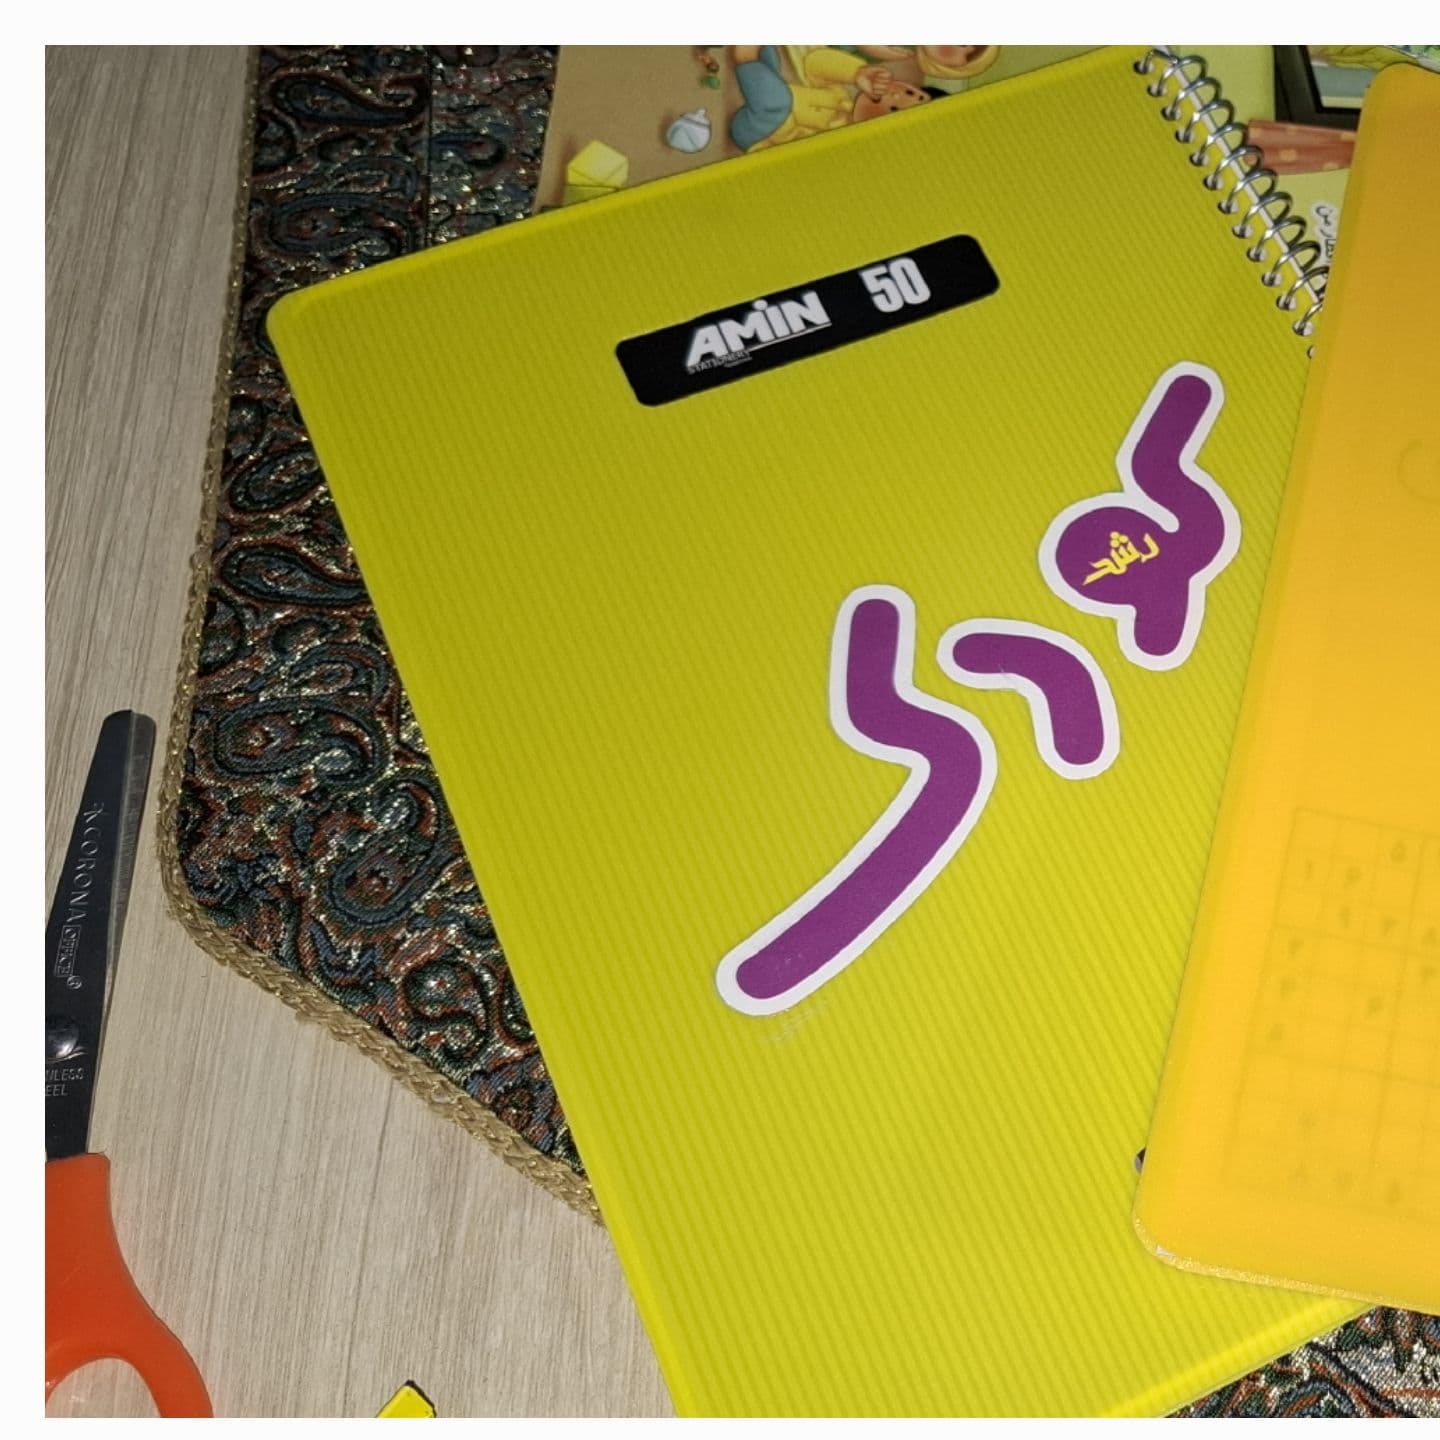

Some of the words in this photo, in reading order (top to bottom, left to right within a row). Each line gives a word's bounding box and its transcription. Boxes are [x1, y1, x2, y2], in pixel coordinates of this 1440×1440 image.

[860, 257, 931, 313] 50
[1082, 530, 1160, 587] رشد
[68, 826, 100, 924] CORONA
